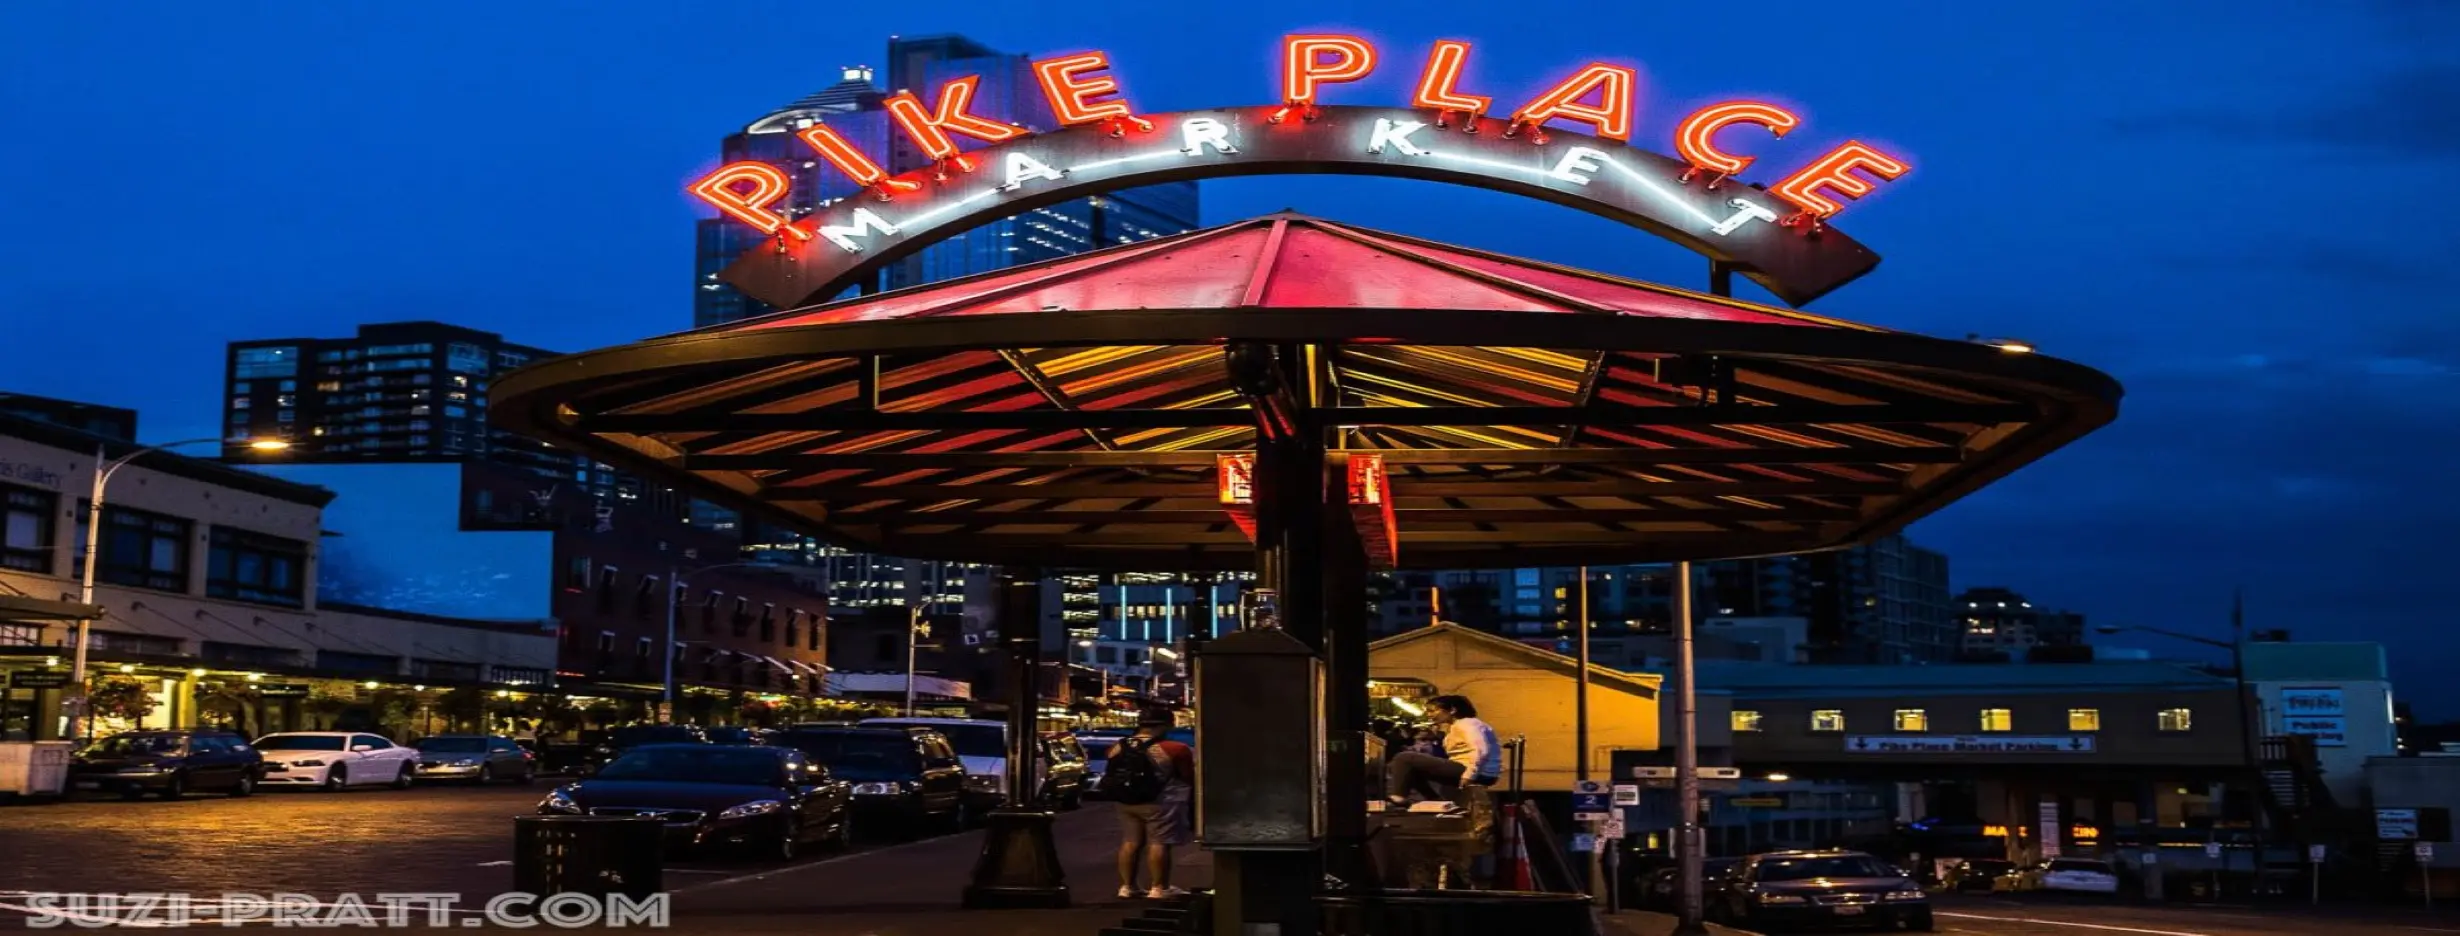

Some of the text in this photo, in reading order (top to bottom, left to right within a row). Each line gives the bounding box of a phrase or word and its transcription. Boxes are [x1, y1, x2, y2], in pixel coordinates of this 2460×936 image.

[687, 34, 1911, 235] PIKE PLACE
[817, 117, 1778, 254] MARKET
